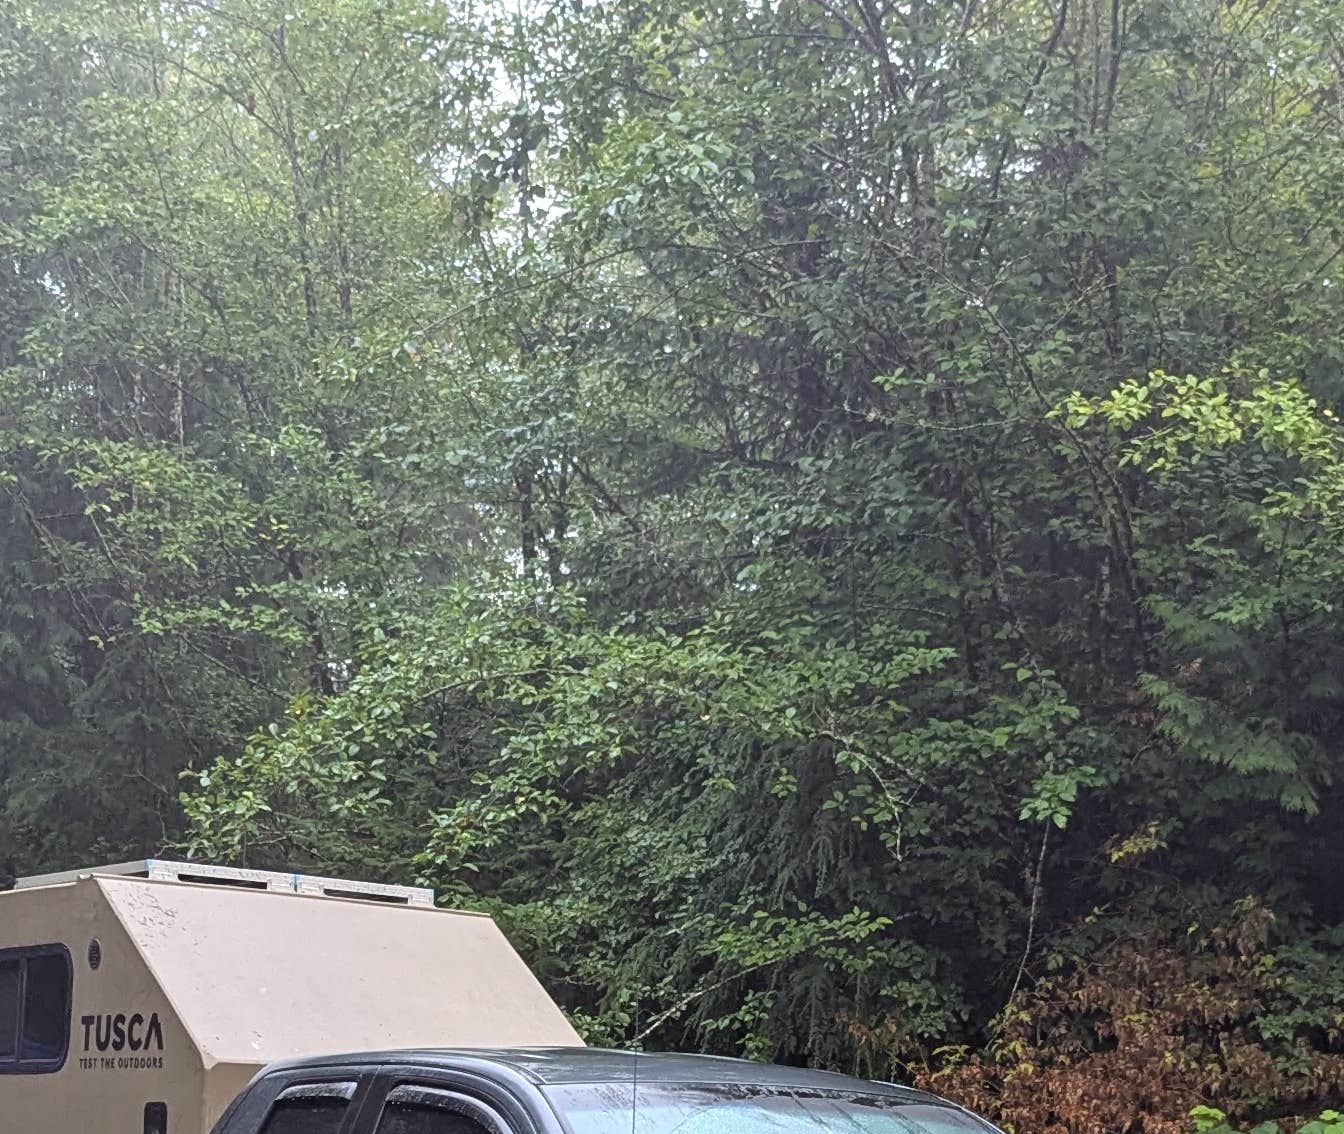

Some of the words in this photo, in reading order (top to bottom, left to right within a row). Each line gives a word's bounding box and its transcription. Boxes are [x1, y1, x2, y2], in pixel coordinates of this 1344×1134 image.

[81, 1013, 163, 1051] TUSCA
[79, 1057, 97, 1070] TEST
[101, 1057, 115, 1069] THE
[118, 1056, 163, 1069] OUTDOORS
